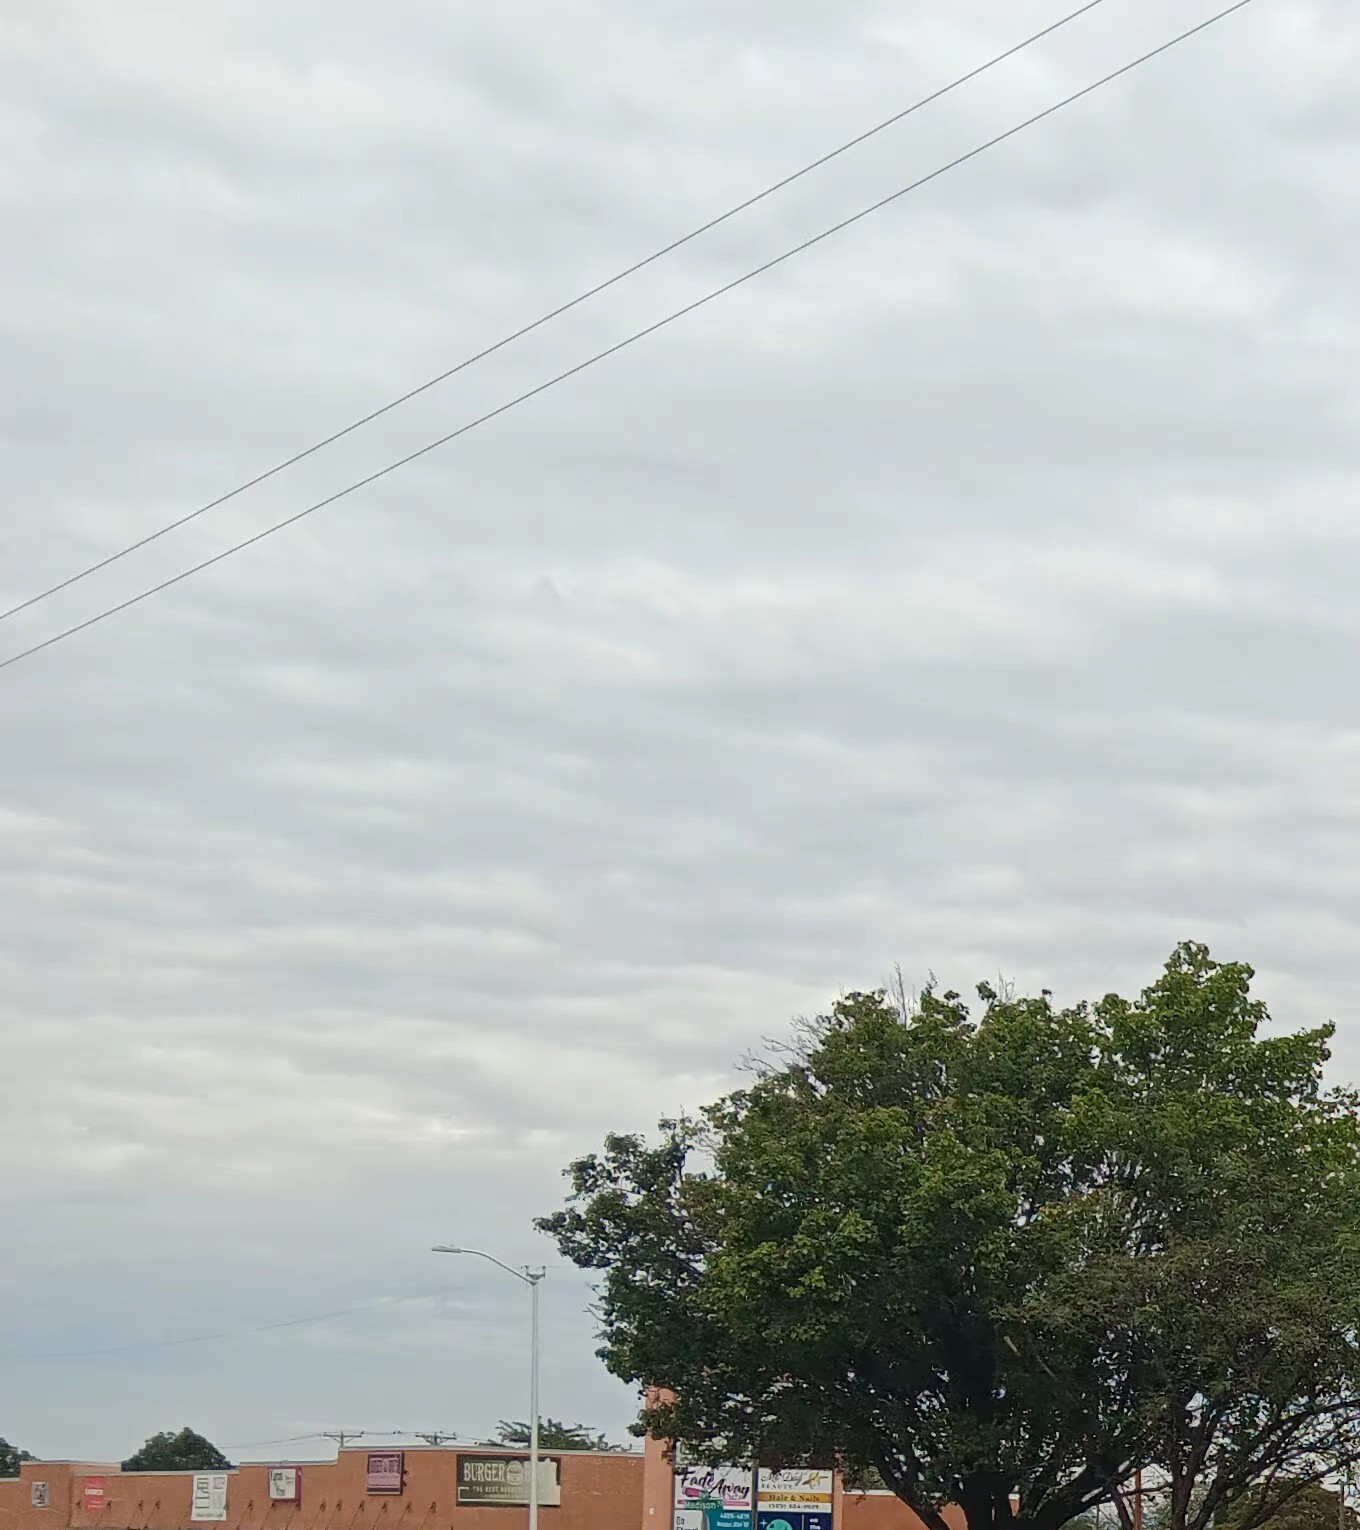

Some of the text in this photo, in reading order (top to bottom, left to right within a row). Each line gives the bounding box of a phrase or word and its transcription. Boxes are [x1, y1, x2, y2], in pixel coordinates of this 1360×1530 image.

[463, 1462, 506, 1482] BURGER
[709, 1478, 750, 1500] Away
[768, 1494, 789, 1502] Hair
